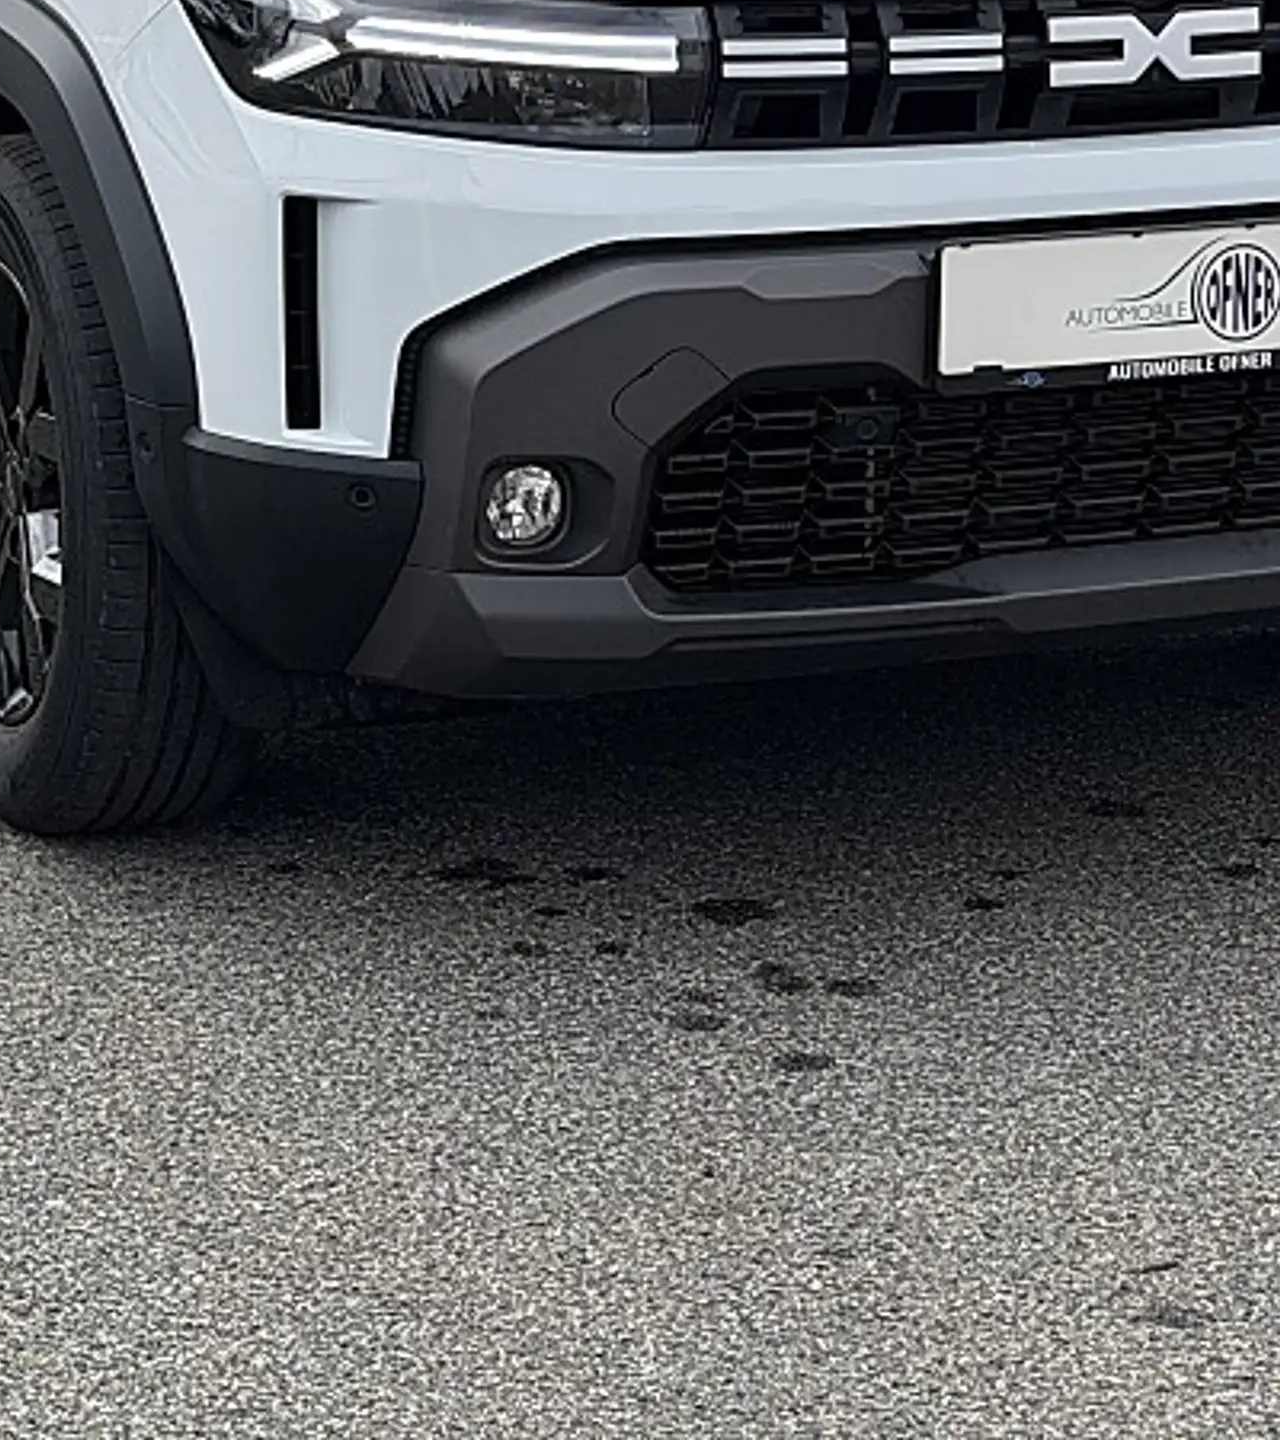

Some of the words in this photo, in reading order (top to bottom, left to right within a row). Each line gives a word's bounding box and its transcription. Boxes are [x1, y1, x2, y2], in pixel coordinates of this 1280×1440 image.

[1065, 300, 1188, 327] AUTOMOBILE
[1207, 252, 1275, 334] OFNER
[1107, 355, 1215, 381] AUTOMOBILE
[1219, 351, 1273, 372] OFNER
